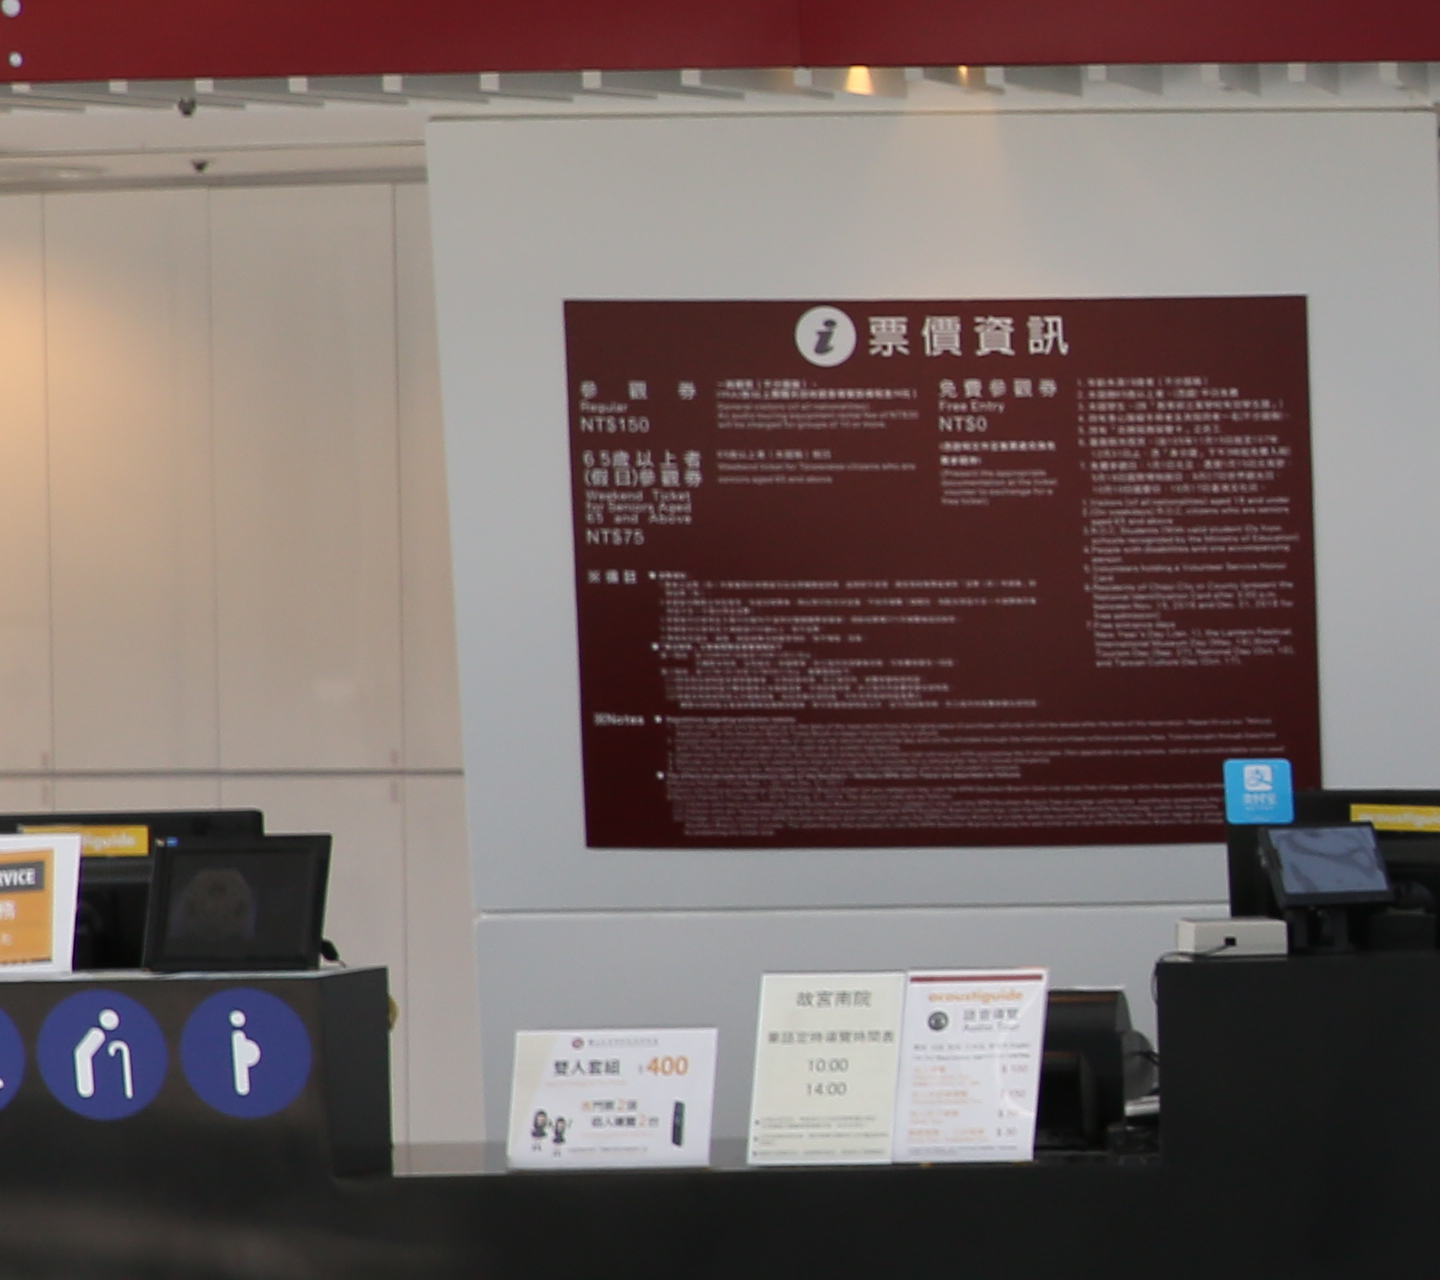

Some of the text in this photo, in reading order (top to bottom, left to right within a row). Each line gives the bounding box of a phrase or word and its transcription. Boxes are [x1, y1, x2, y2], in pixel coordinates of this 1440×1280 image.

[868, 314, 1070, 359] 票價資訊
[579, 401, 629, 413] Regular
[939, 400, 1006, 414] Free Entry
[580, 416, 650, 433] NT$150
[938, 416, 988, 433] NT$0
[585, 528, 645, 546] NT$75
[796, 990, 873, 1008] 故宮南院
[808, 1057, 849, 1073] 10:00
[806, 1082, 847, 1096] 14:00
